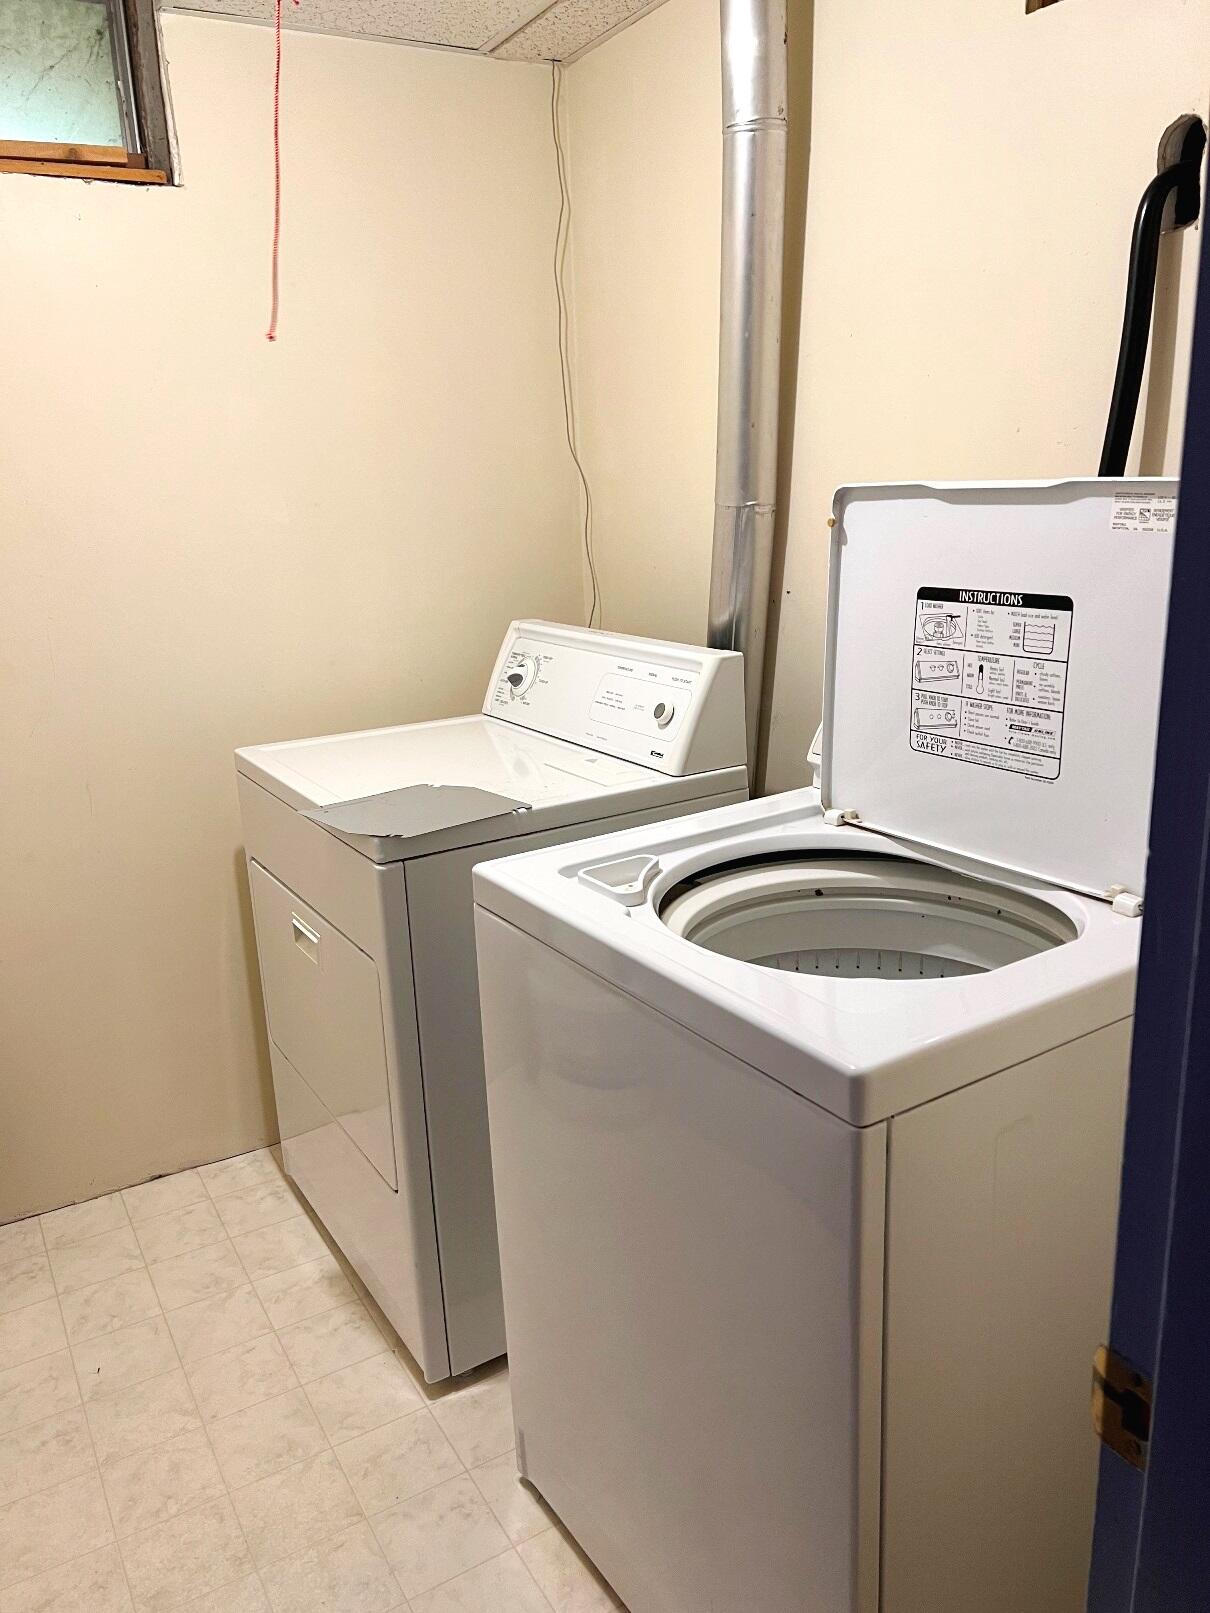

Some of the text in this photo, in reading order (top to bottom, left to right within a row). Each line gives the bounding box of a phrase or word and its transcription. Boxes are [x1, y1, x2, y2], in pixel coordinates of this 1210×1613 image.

[959, 591, 1023, 606] INSTRUCTIONS
[921, 602, 924, 610] 1
[916, 647, 923, 656] 2
[977, 655, 1001, 665] TEMPERATURE
[1033, 661, 1045, 670] CYCLE
[914, 693, 920, 701] 3
[969, 701, 983, 709] WASHER
[1014, 708, 1025, 717] MORE
[1025, 711, 1051, 720] INFORMATION
[916, 734, 928, 742] FOR
[929, 736, 948, 746] YOUR
[916, 740, 947, 754] SAFETY
